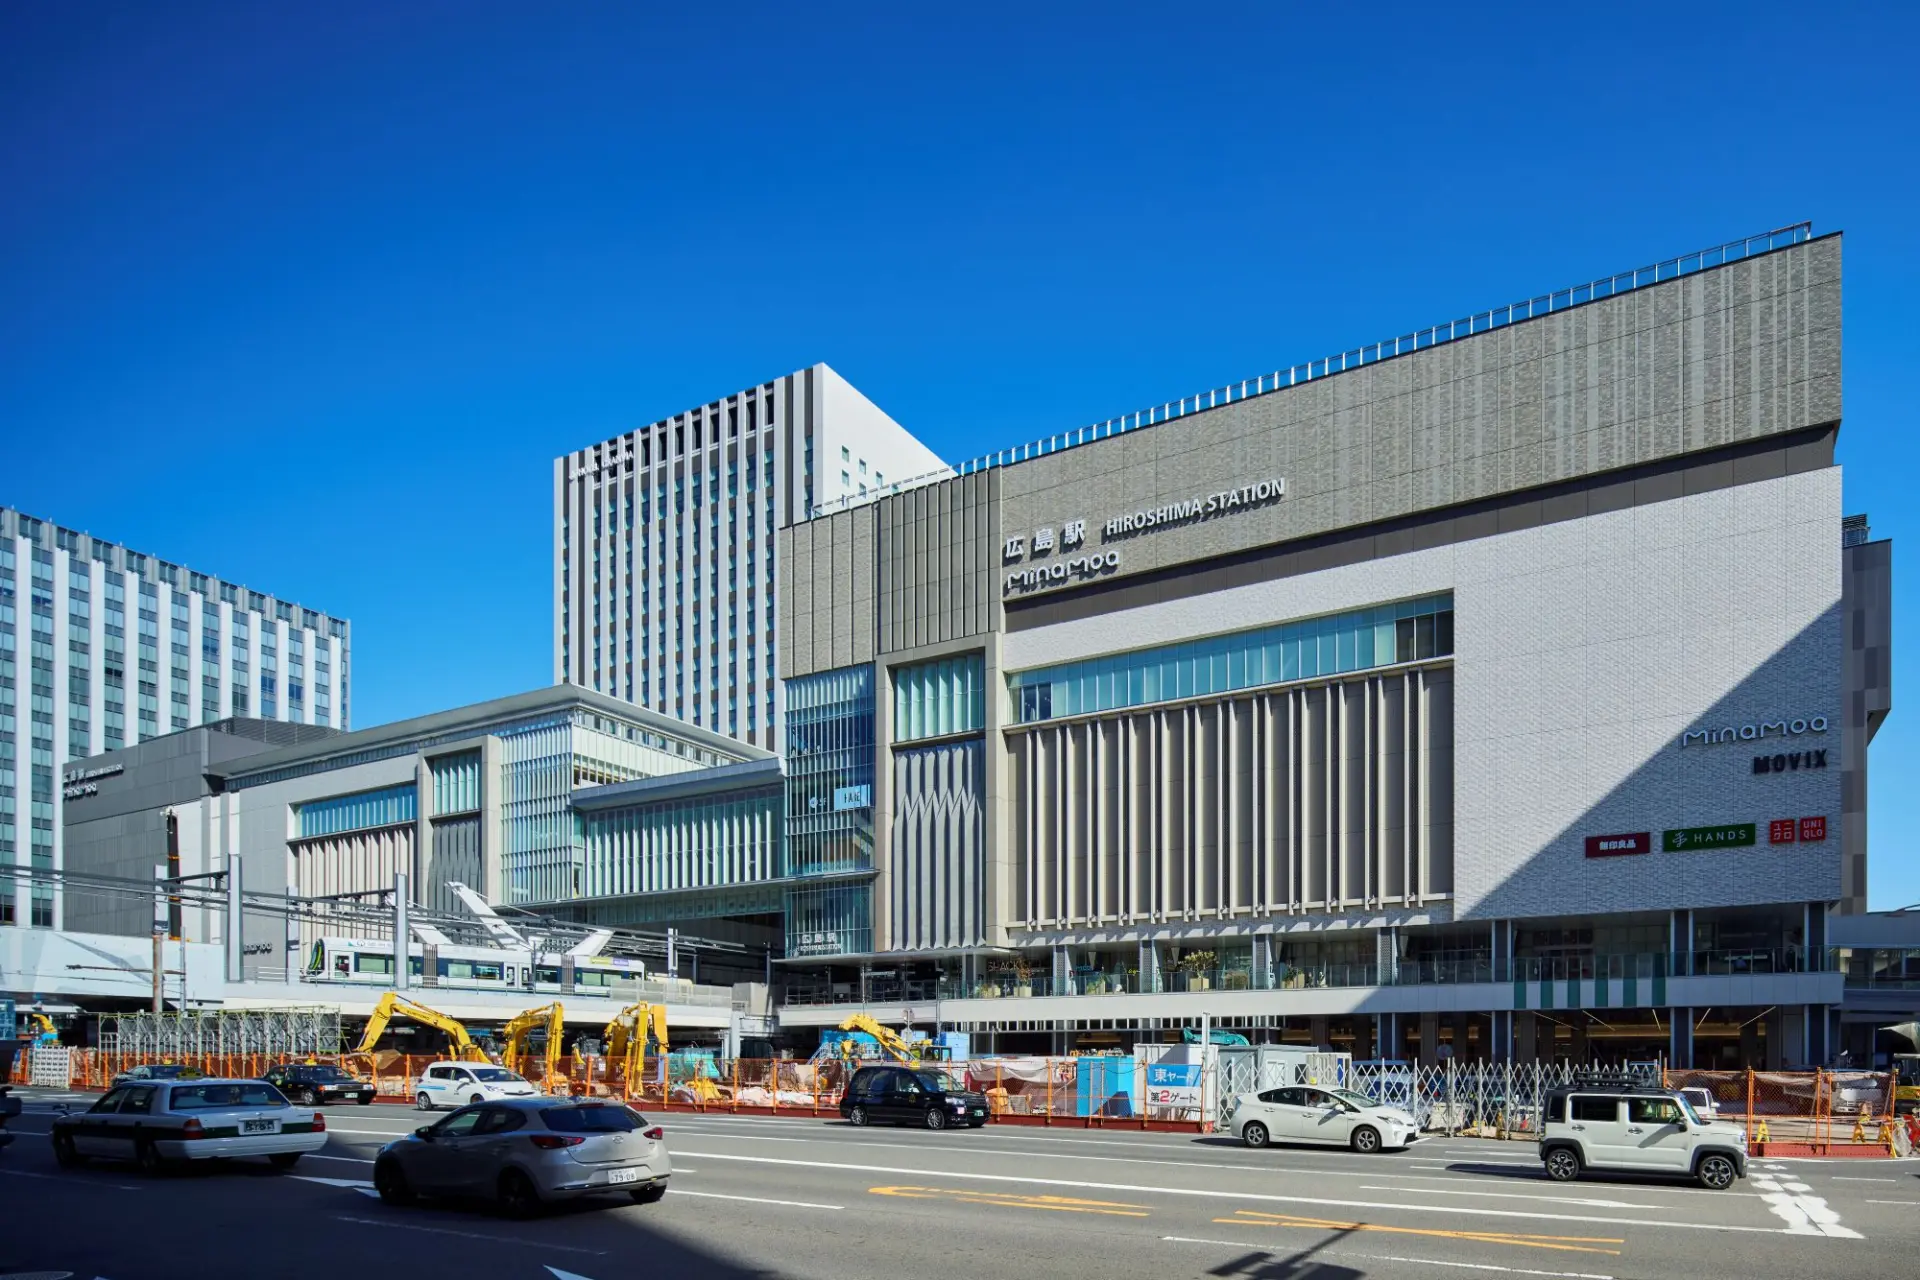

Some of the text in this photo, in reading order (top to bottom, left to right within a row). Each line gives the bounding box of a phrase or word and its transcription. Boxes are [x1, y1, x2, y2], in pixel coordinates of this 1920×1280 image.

[1106, 477, 1286, 536] HIROSHIMA STATION
[1005, 519, 1086, 558] 広島駅
[1753, 749, 1828, 775] MOVIX
[1694, 829, 1747, 844] HANDS
[1150, 1090, 1198, 1104] 第2ゲート
